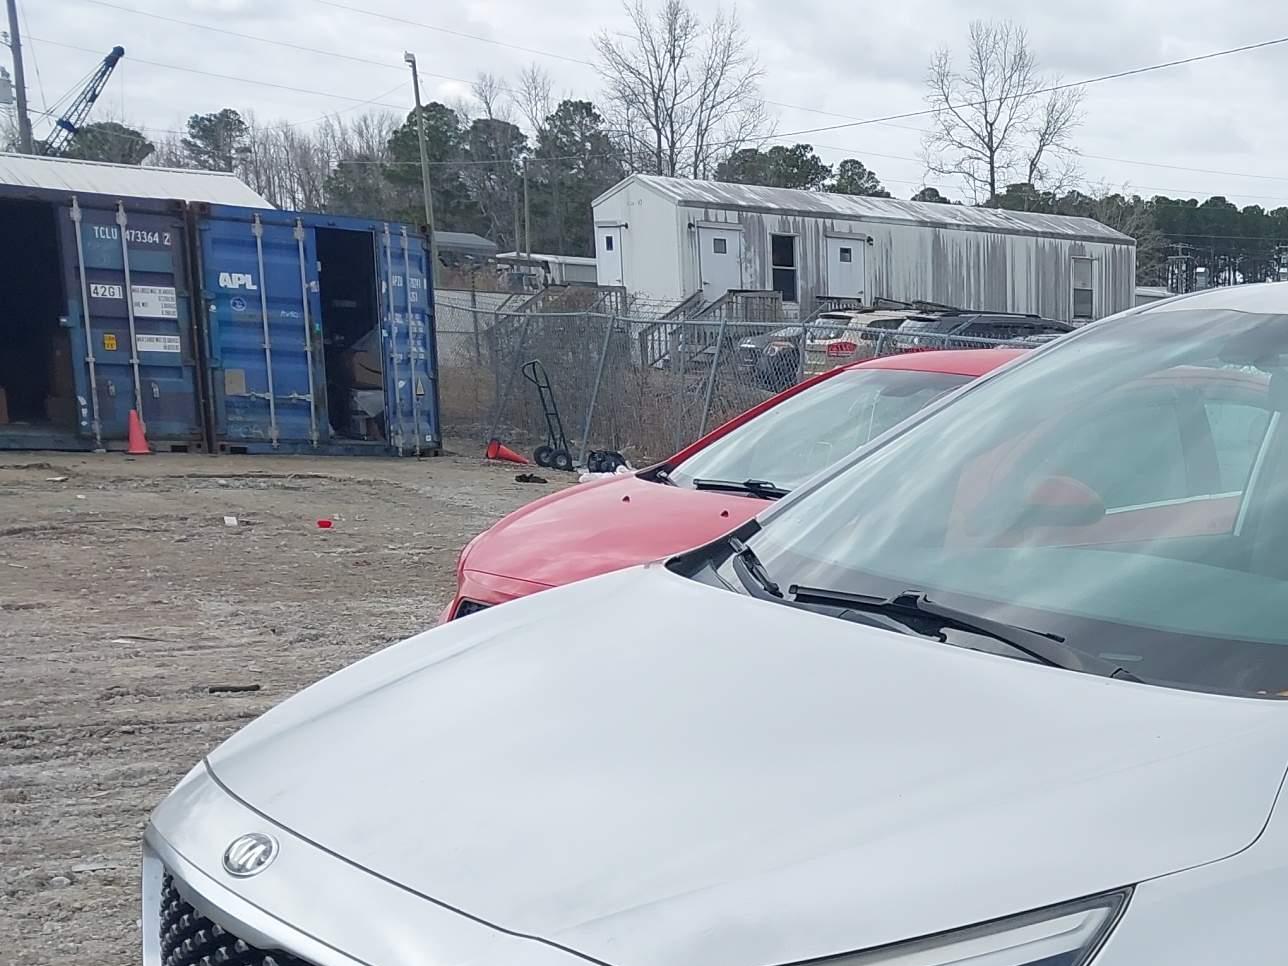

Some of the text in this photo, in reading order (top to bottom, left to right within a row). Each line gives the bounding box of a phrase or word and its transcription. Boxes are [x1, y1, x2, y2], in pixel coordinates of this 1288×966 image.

[94, 226, 118, 240] TCLU
[163, 232, 172, 246] 2
[219, 272, 258, 290] APL
